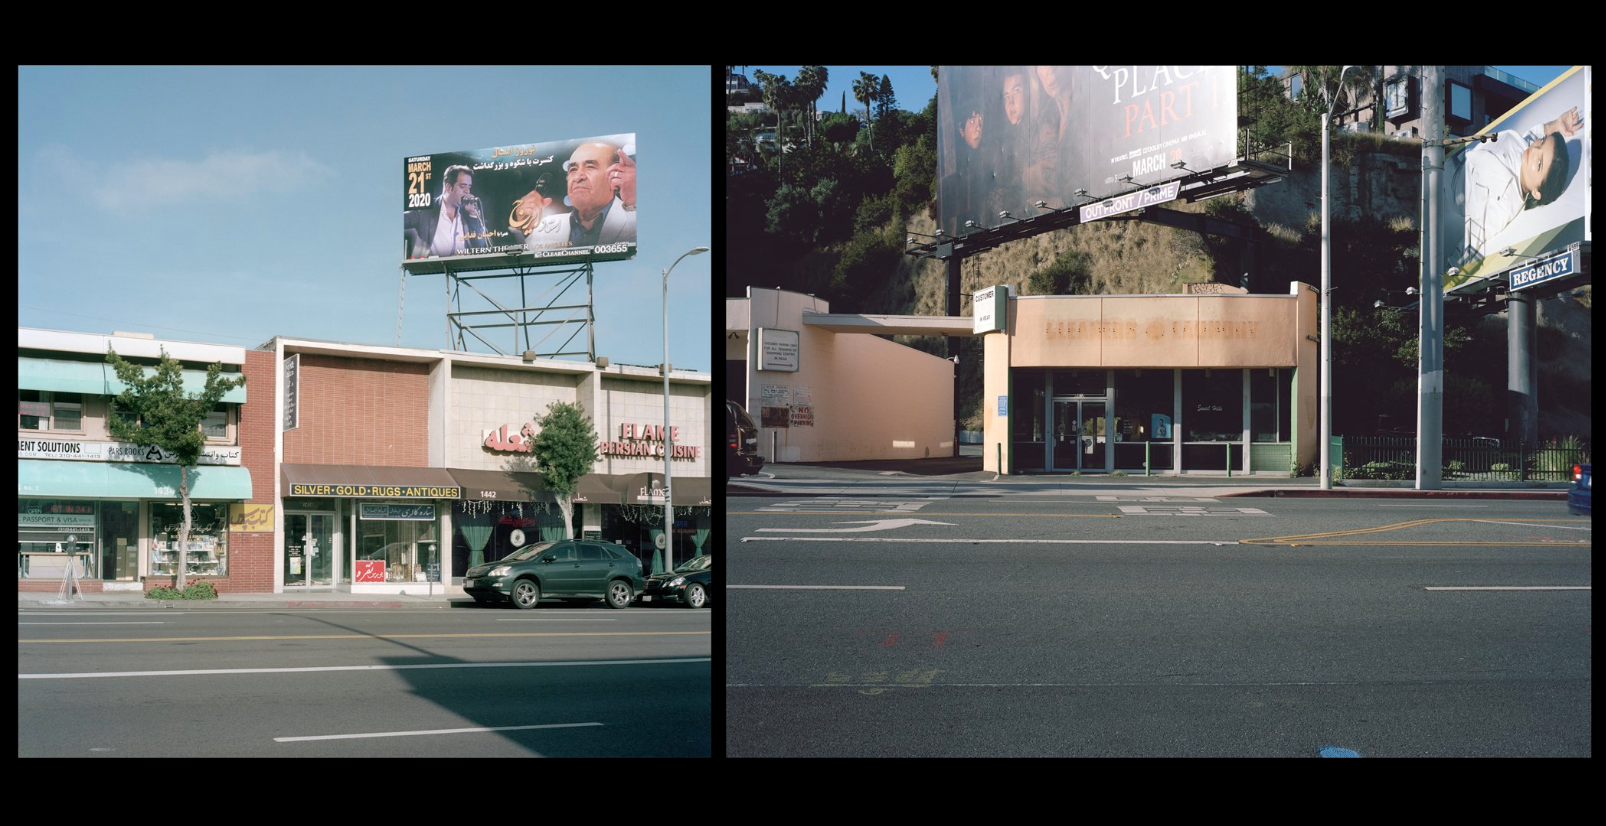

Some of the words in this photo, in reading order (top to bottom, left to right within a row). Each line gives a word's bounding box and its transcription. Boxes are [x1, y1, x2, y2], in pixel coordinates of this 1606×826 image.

[1124, 80, 1200, 139] PART
[408, 162, 432, 173] MARCH
[1132, 153, 1166, 177] MARCH
[408, 192, 431, 208] 2020
[1085, 196, 1135, 219] OUTFRONT
[1144, 185, 1174, 204] PRIME
[456, 245, 492, 255] WILTERN
[594, 244, 628, 254] 003655
[1513, 257, 1569, 287] REGENCY
[38, 442, 81, 453] SOLUTIONS
[108, 446, 122, 456] PARS
[124, 447, 145, 456] BOOKS
[601, 442, 651, 456] PERSIAN
[294, 485, 331, 495] SILVER
[336, 486, 367, 496] GOLD
[373, 487, 401, 497] RUGS
[405, 487, 458, 498] ANTIQUES
[480, 490, 497, 499] 1442
